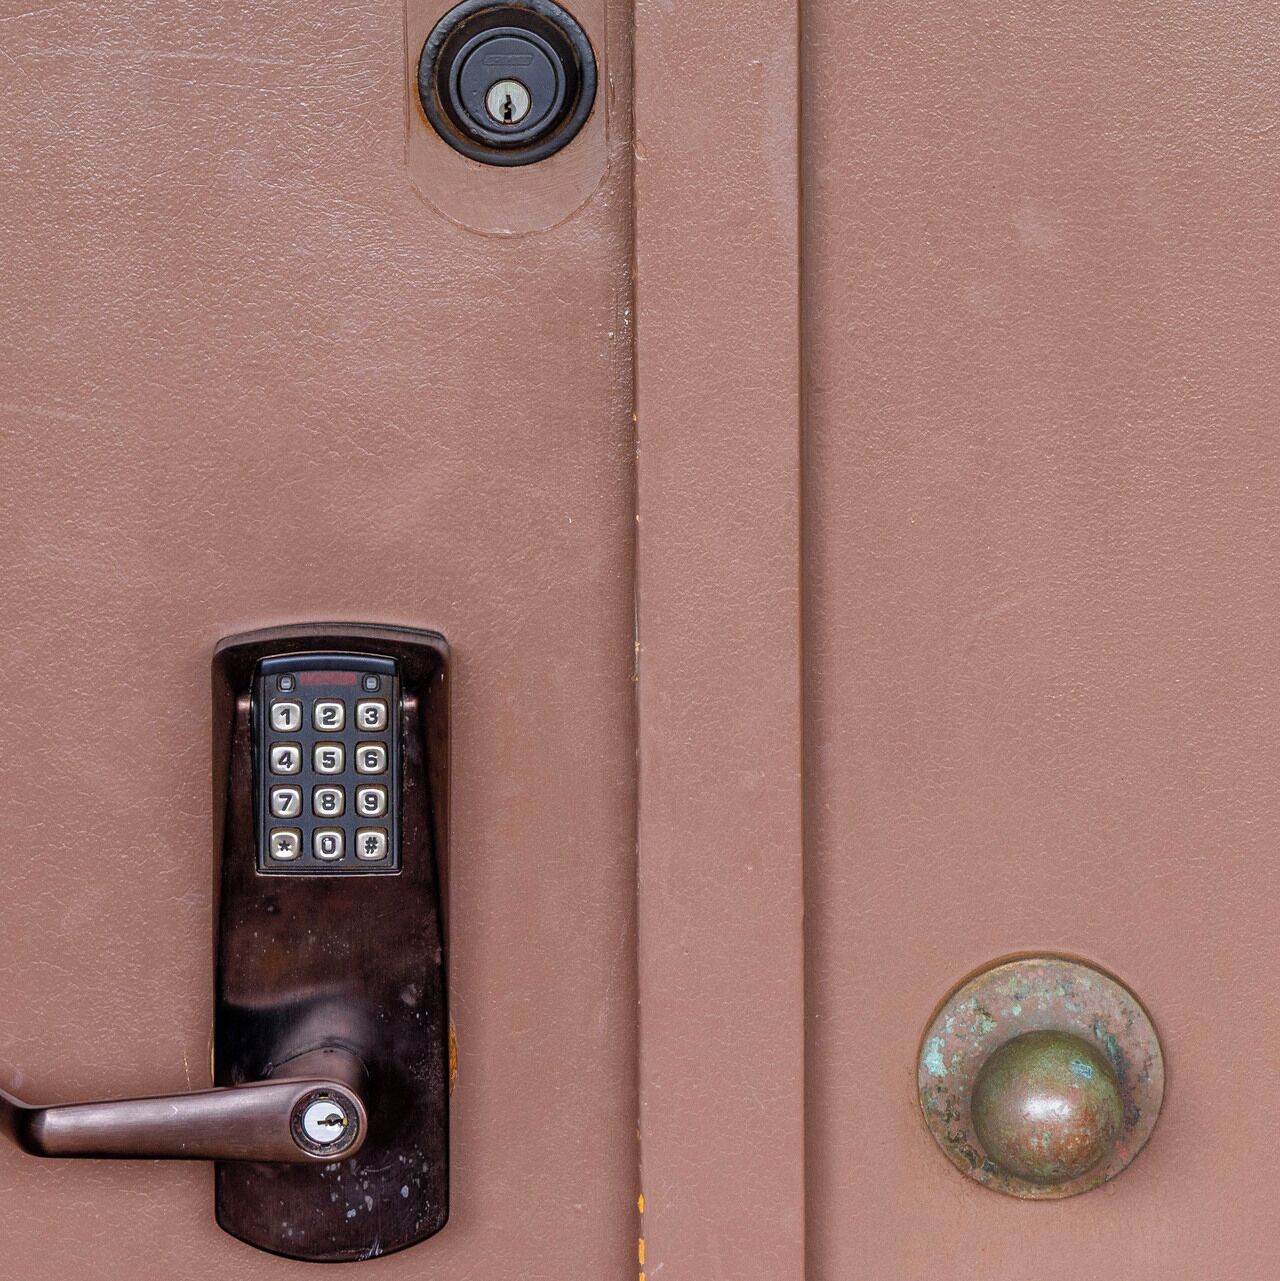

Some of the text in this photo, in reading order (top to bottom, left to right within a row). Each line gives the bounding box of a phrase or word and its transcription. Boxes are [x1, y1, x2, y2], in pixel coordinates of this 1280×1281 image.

[280, 708, 379, 725] 1 2 3
[278, 751, 378, 769] 4 5 6
[279, 794, 378, 811] 7 8 9
[321, 837, 336, 853] 0
[365, 837, 379, 854] #
